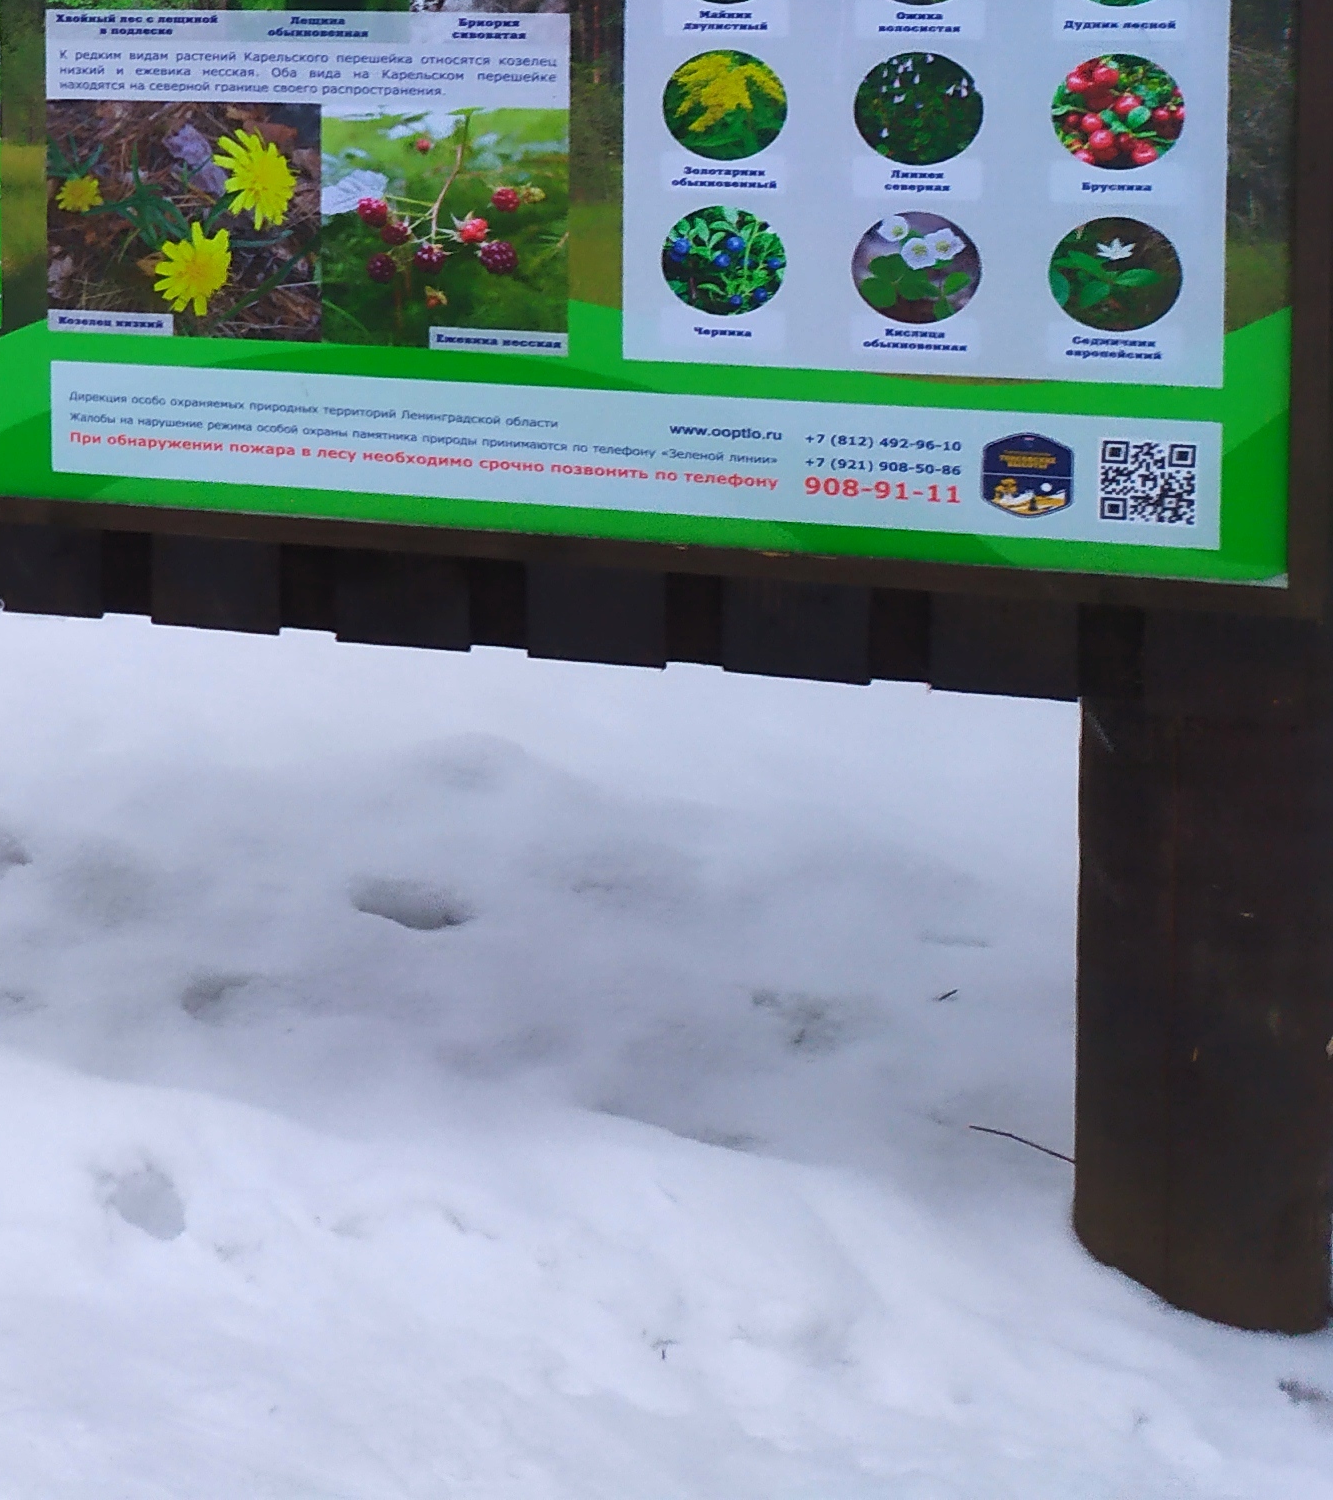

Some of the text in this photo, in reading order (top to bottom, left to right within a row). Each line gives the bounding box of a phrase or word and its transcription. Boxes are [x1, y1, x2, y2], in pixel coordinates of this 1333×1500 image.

[68, 390, 559, 428] Дирекция особо охраняемых природных территорий Ленинградской области
[668, 425, 783, 440] www.ooptlo.ru
[804, 432, 962, 451] +7 (812) 492-96-10
[69, 431, 779, 490] При обнаружении пожара в лесу необходимо срочно позвонить по телефону
[805, 456, 962, 475] +7 (921) 908-50-86
[804, 476, 961, 503] 908-91-11
